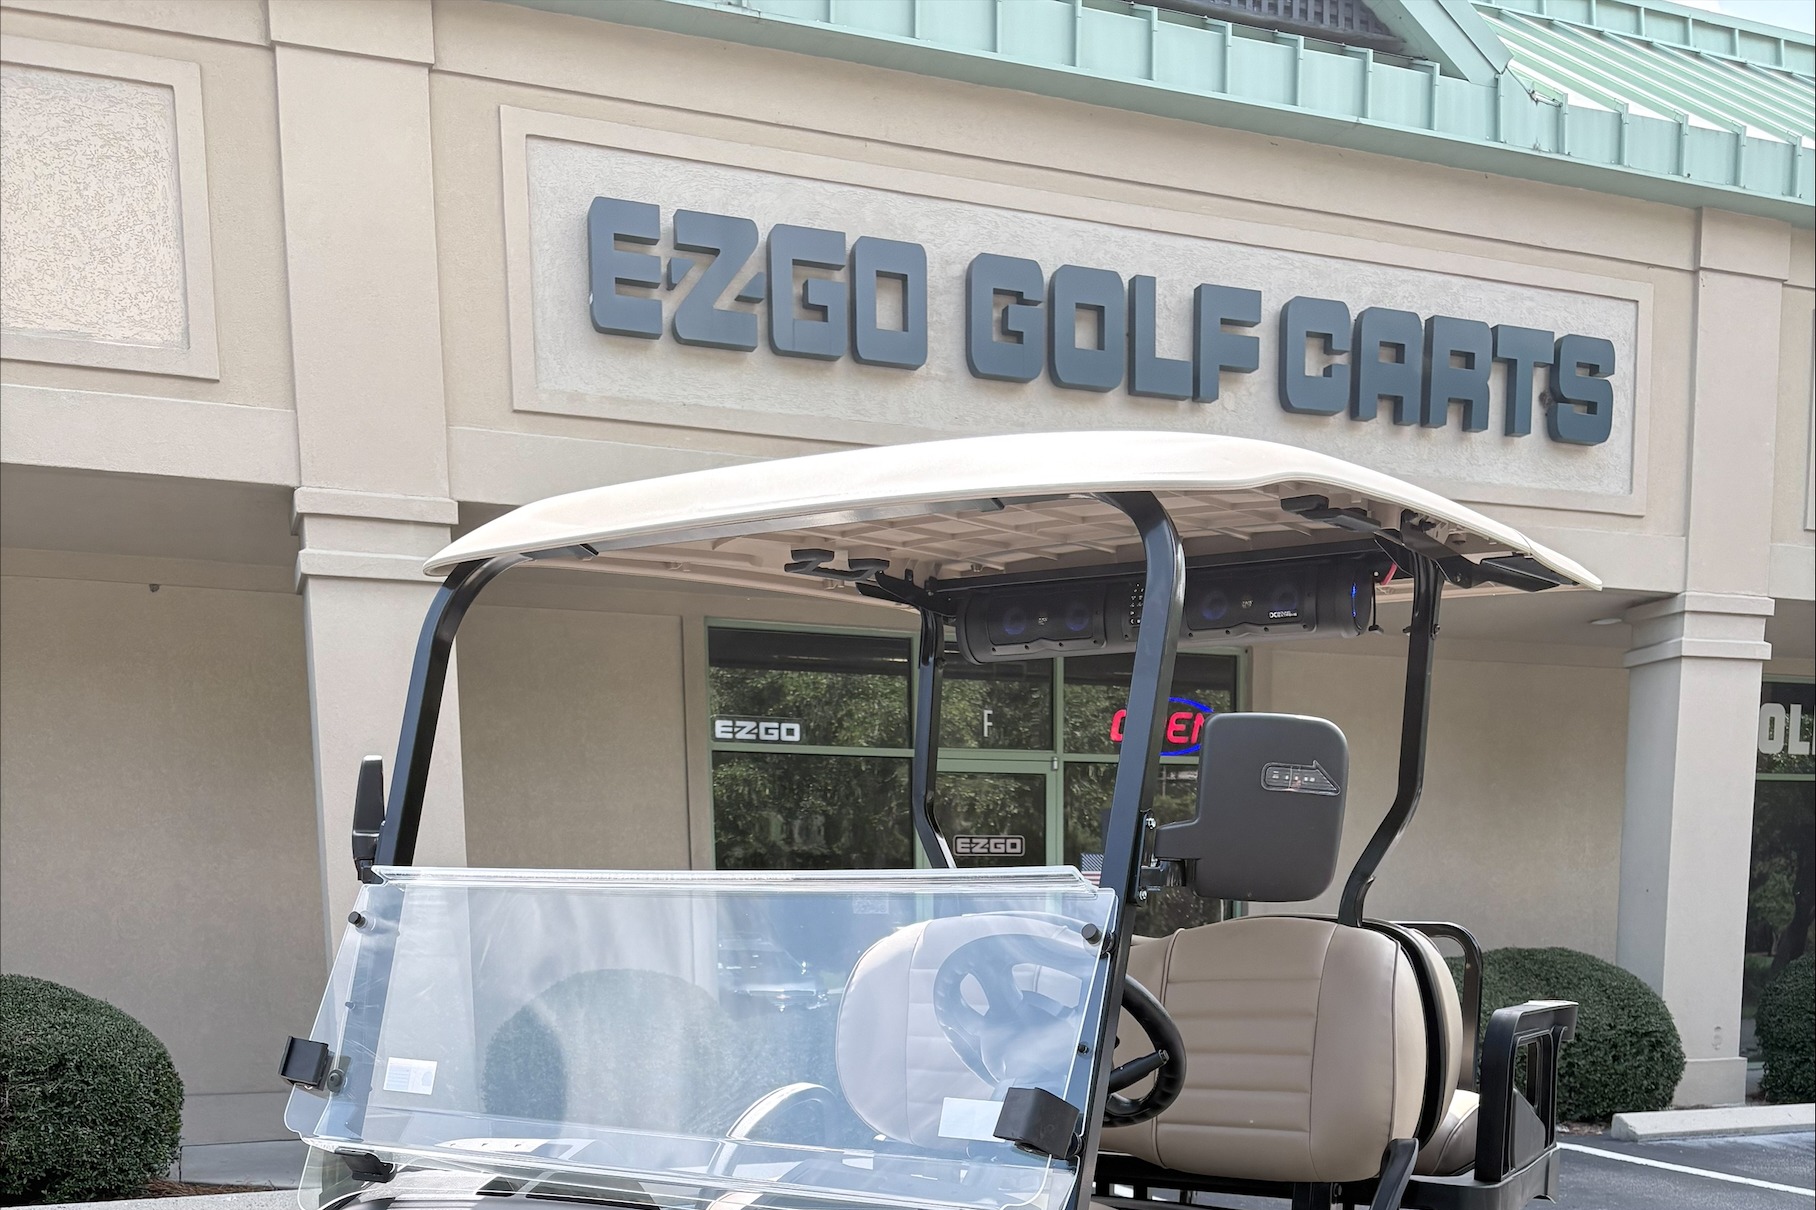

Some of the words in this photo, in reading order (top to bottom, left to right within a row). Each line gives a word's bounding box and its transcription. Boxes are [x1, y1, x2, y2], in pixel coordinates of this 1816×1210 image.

[588, 196, 928, 370] EZGO
[967, 252, 1262, 403] GOLF
[1277, 295, 1616, 446] CARTS
[715, 719, 801, 742] EZGO
[983, 710, 993, 737] F
[1759, 702, 1816, 755] OL
[956, 838, 1022, 853] EZGO
